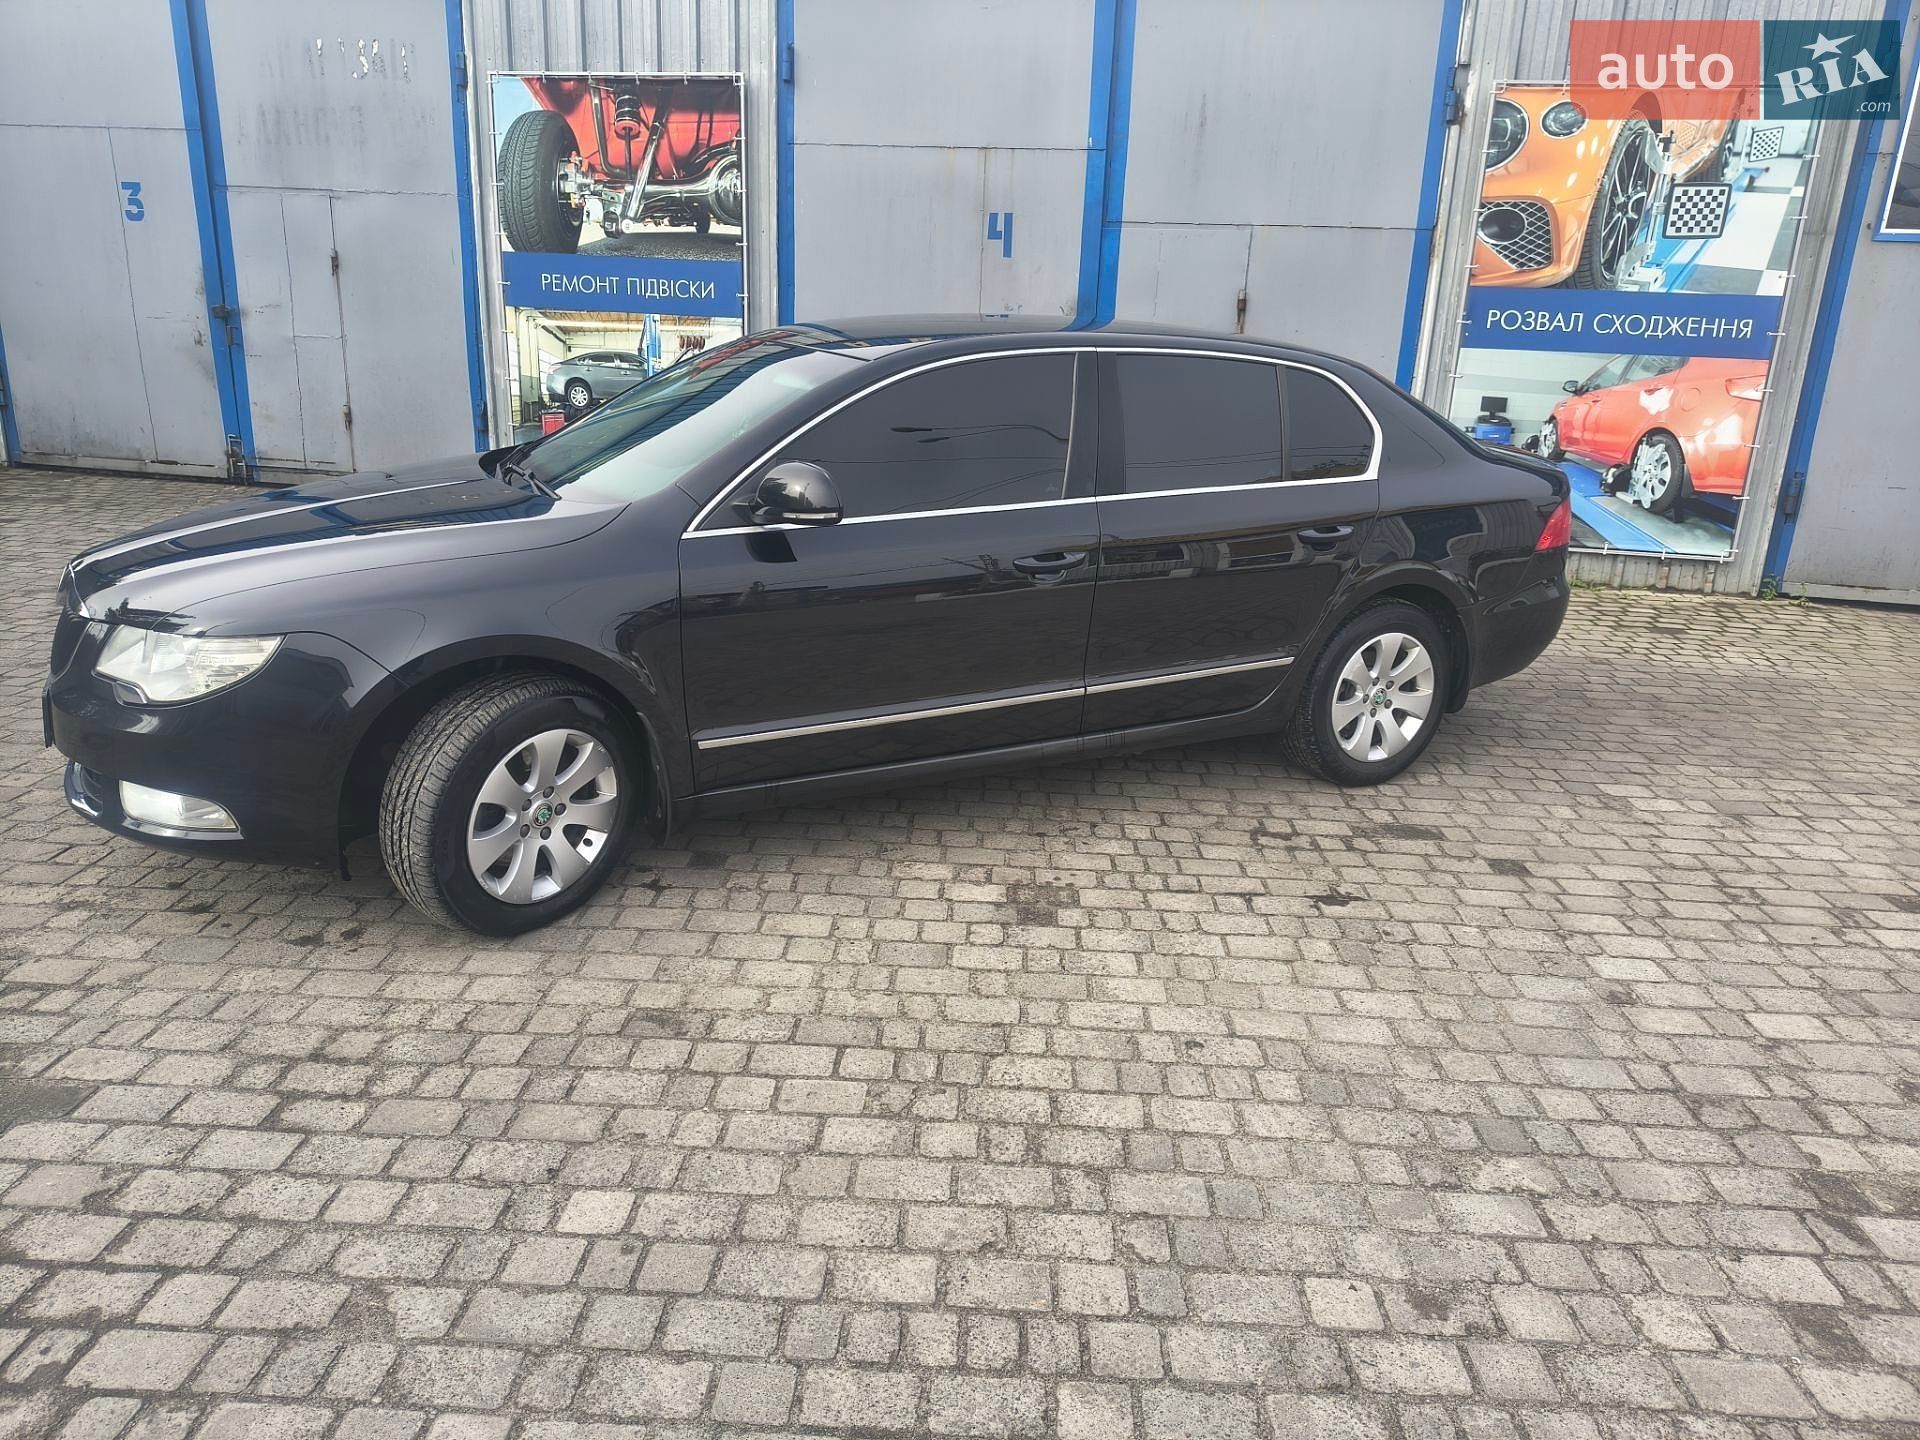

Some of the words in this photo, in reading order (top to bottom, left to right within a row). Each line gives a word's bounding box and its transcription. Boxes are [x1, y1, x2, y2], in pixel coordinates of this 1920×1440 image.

[120, 181, 145, 222] 3
[987, 212, 1013, 258] 4
[541, 273, 619, 295] РЕМОНТ
[627, 277, 715, 300] ПІДВІСКИ
[1486, 310, 1584, 333] РОЗВАЛ
[1593, 313, 1752, 339] СХОДЖЕННЯ
